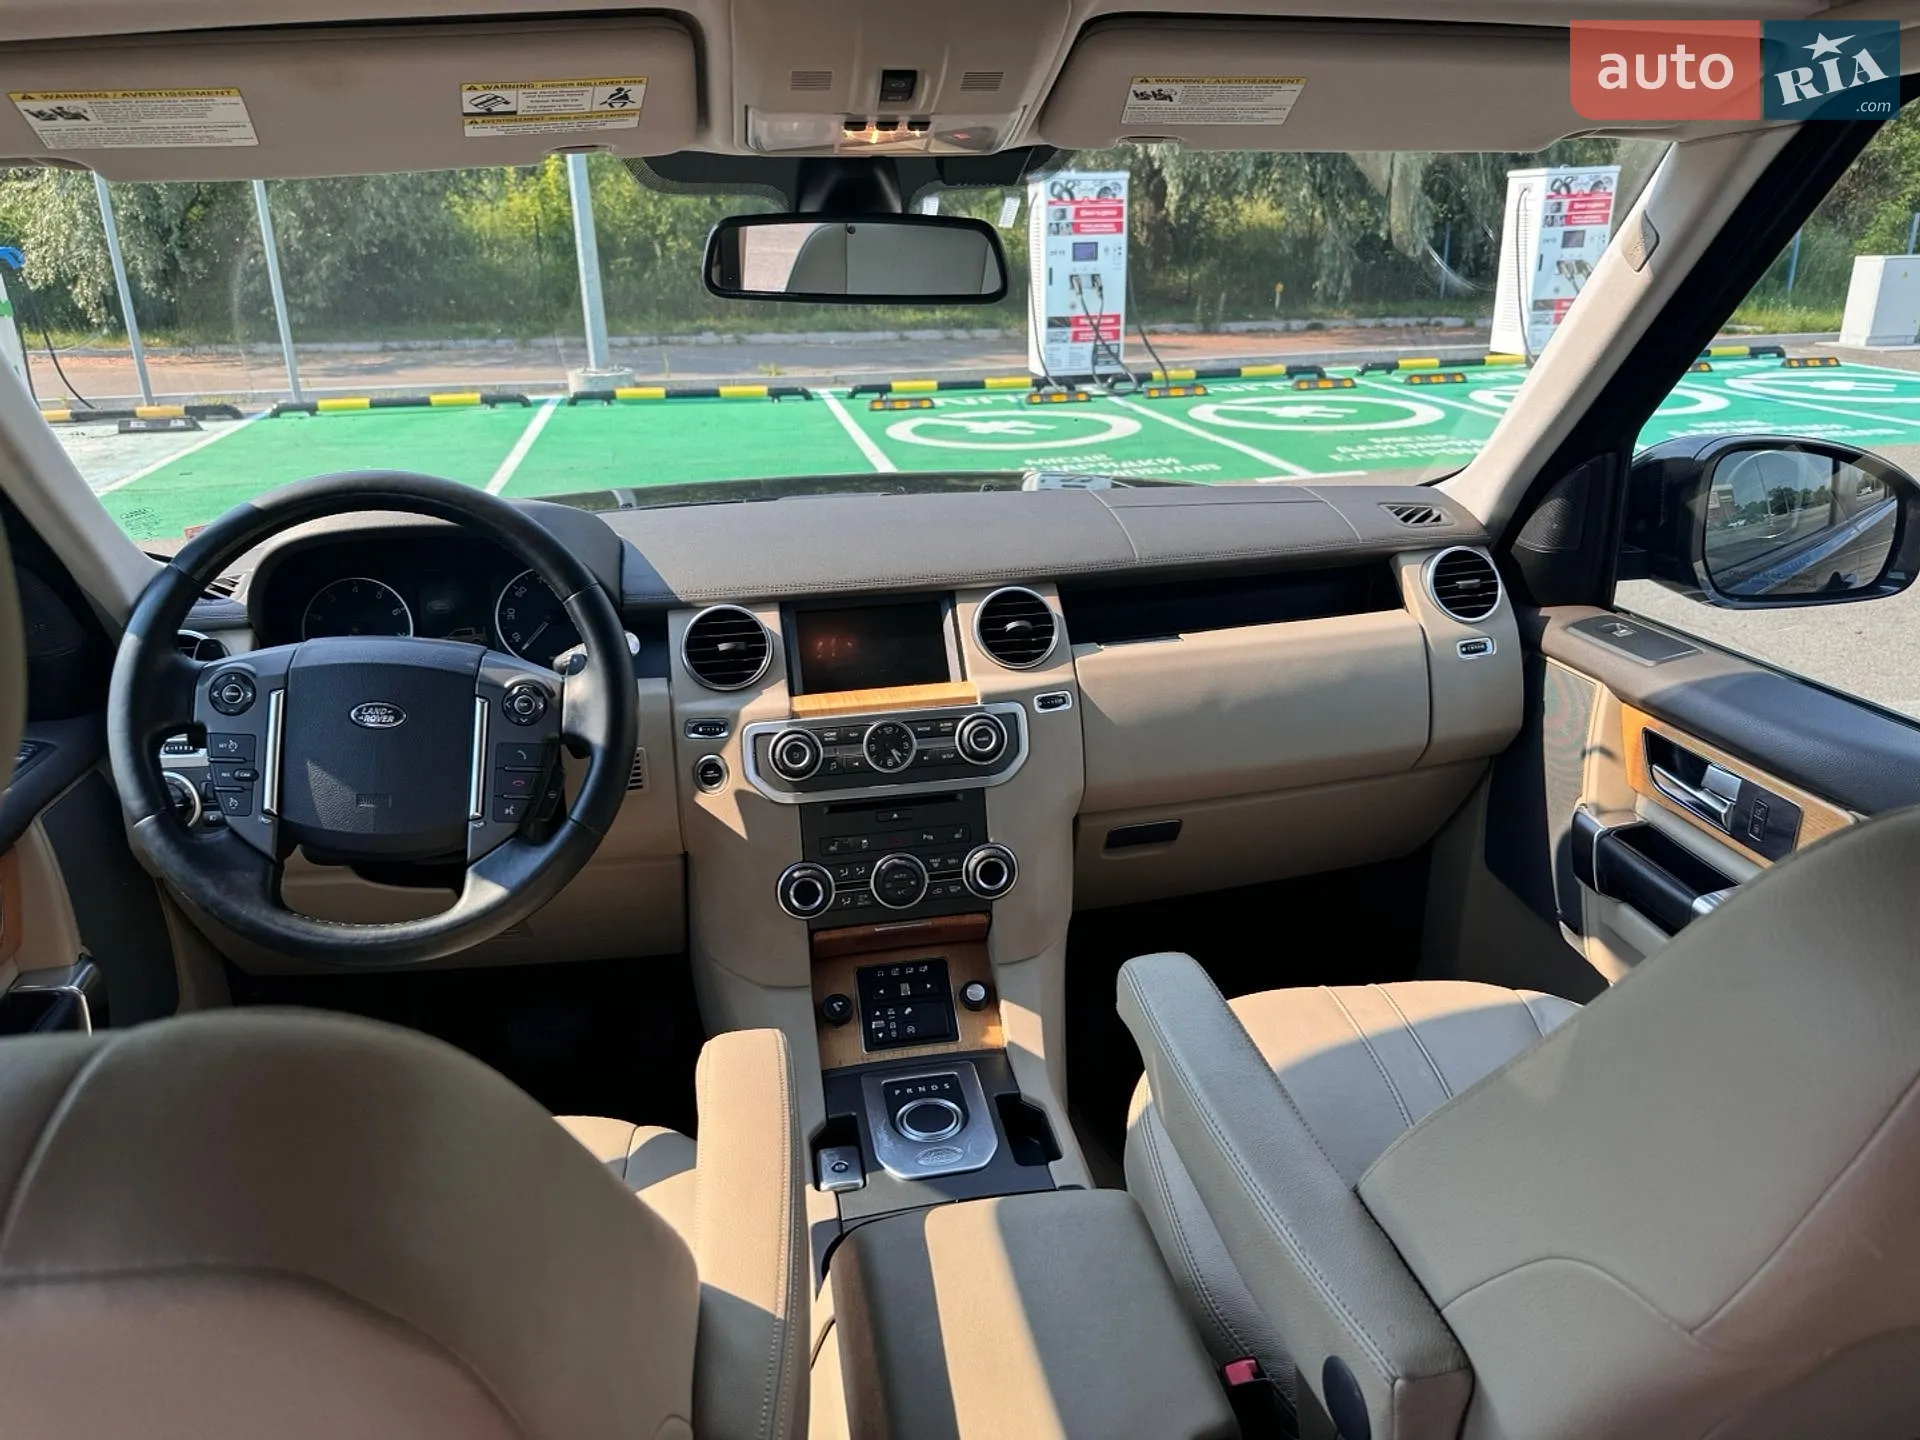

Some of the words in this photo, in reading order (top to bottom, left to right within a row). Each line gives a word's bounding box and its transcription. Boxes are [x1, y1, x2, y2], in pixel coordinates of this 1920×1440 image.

[40, 92, 109, 100] WARNING
[121, 89, 233, 99] AVERTISSEMENT
[363, 715, 395, 723] ROVER
